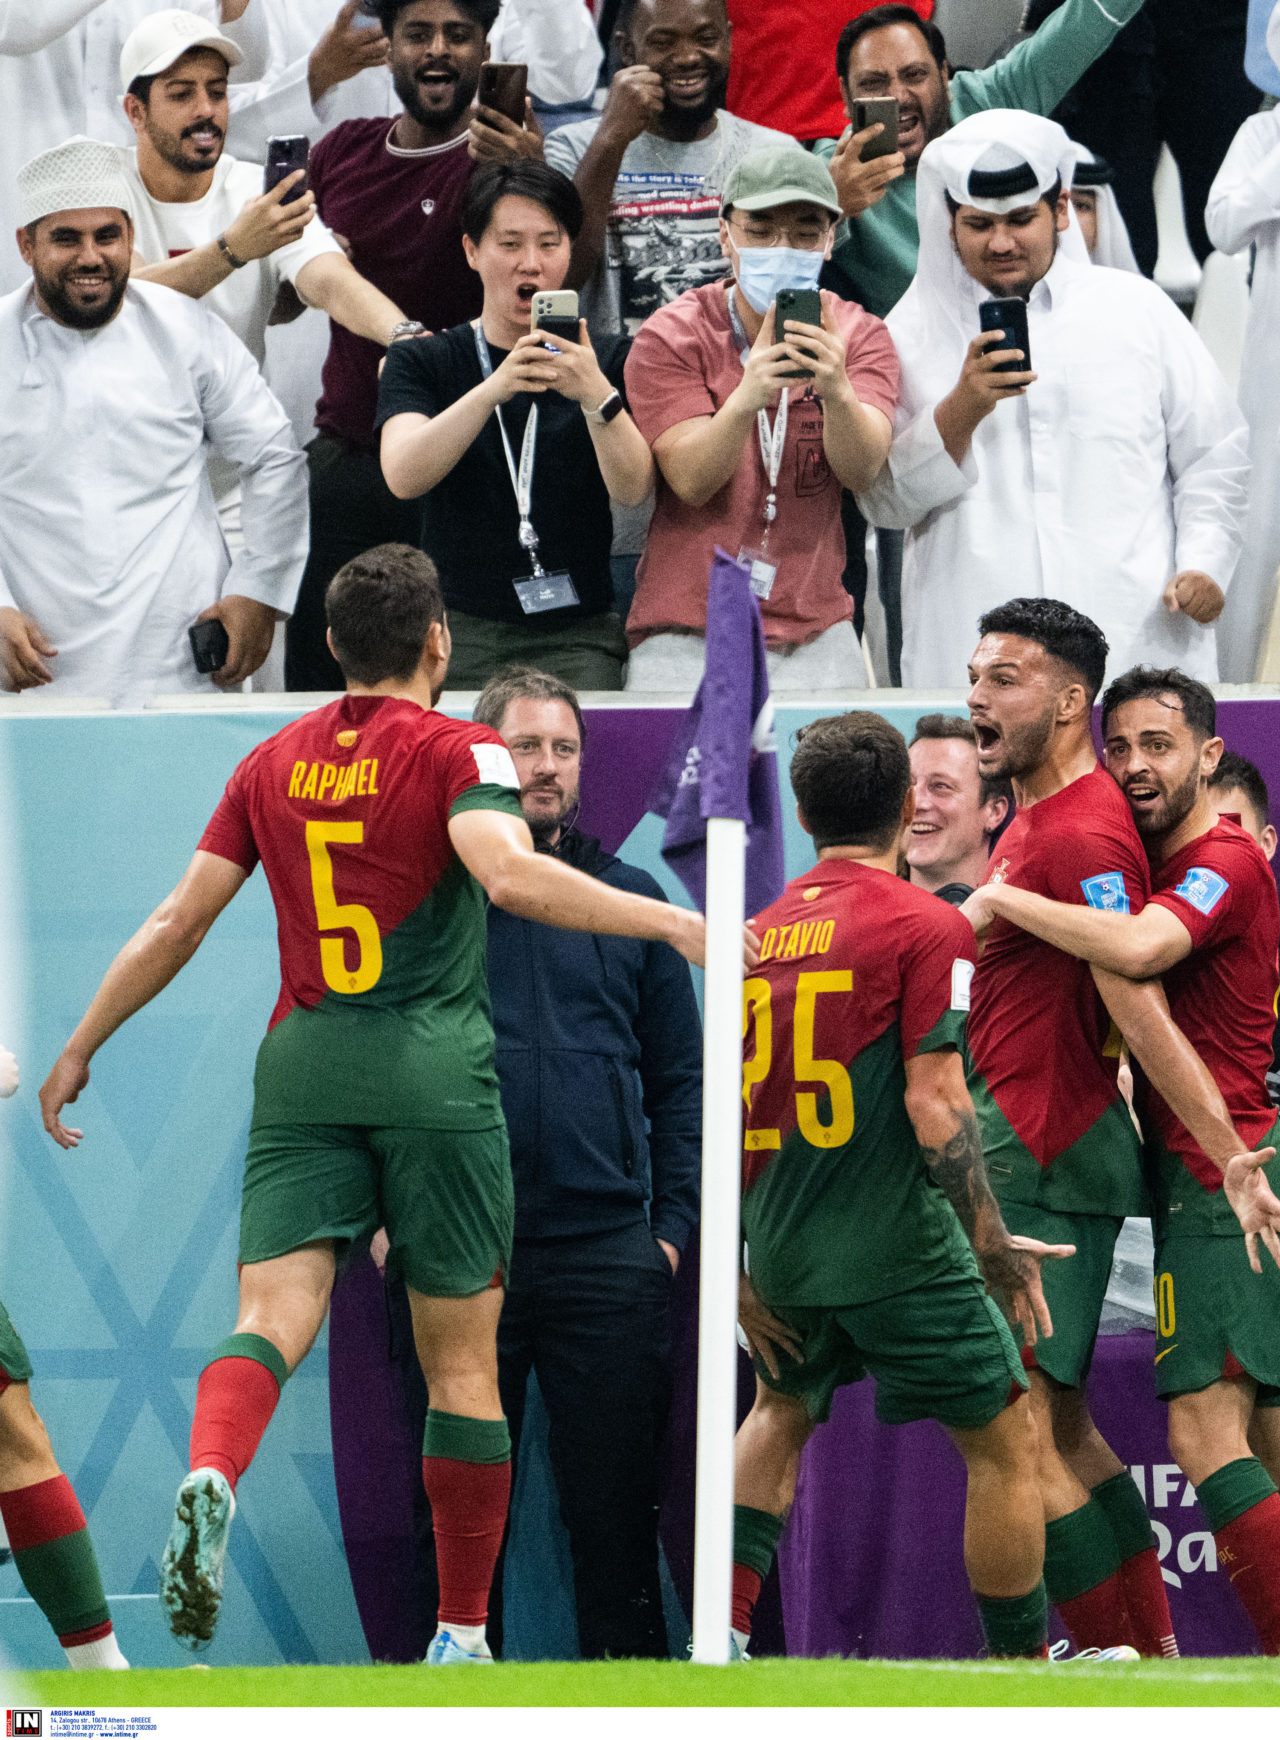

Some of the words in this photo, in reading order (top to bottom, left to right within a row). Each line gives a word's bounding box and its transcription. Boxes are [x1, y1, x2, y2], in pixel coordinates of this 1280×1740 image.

[288, 758, 379, 801] RAPHAEL
[305, 820, 383, 994] 5
[760, 919, 835, 961] OTAVIO
[743, 970, 855, 1150] 25
[1154, 1272, 1176, 1340] 0
[1124, 1464, 1199, 1508] IFA
